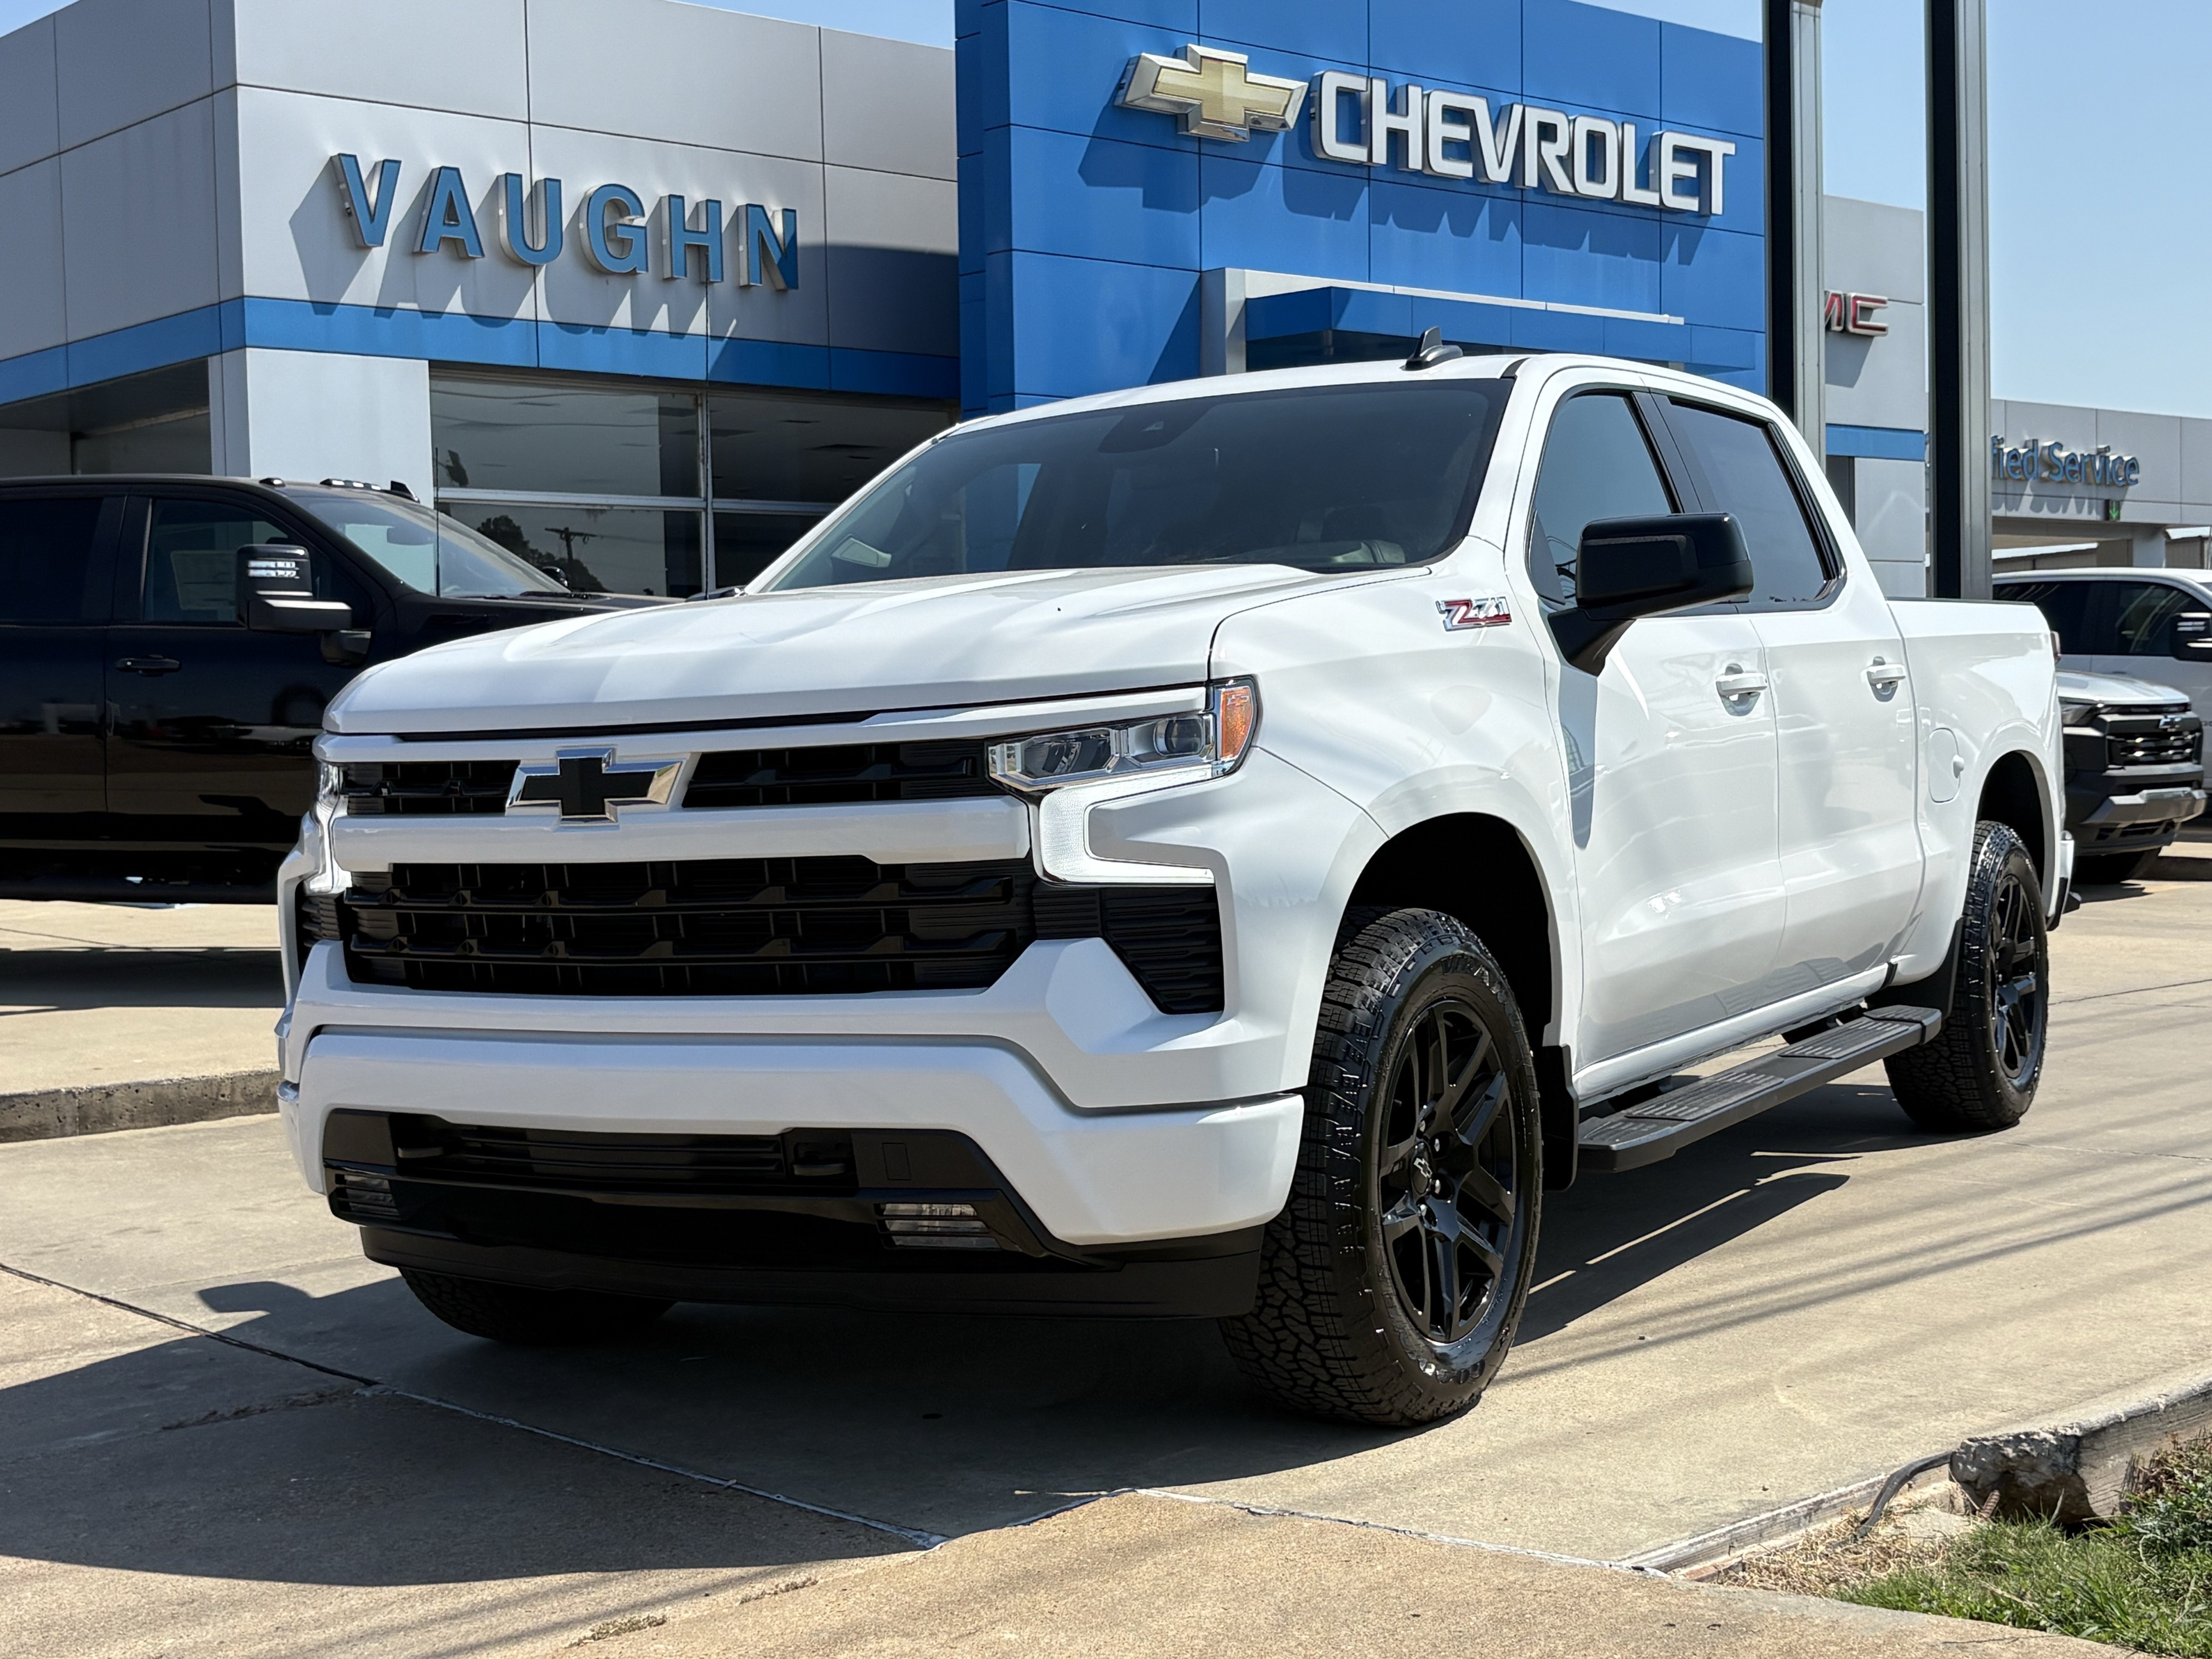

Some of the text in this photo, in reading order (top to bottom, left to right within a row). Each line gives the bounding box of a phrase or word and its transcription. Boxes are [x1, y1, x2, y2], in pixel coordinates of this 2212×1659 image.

[1310, 69, 1736, 216] CHEVROLET
[331, 153, 799, 290] VAUGHN
[2042, 441, 2140, 487] Service
[1435, 596, 1512, 632] Z71
